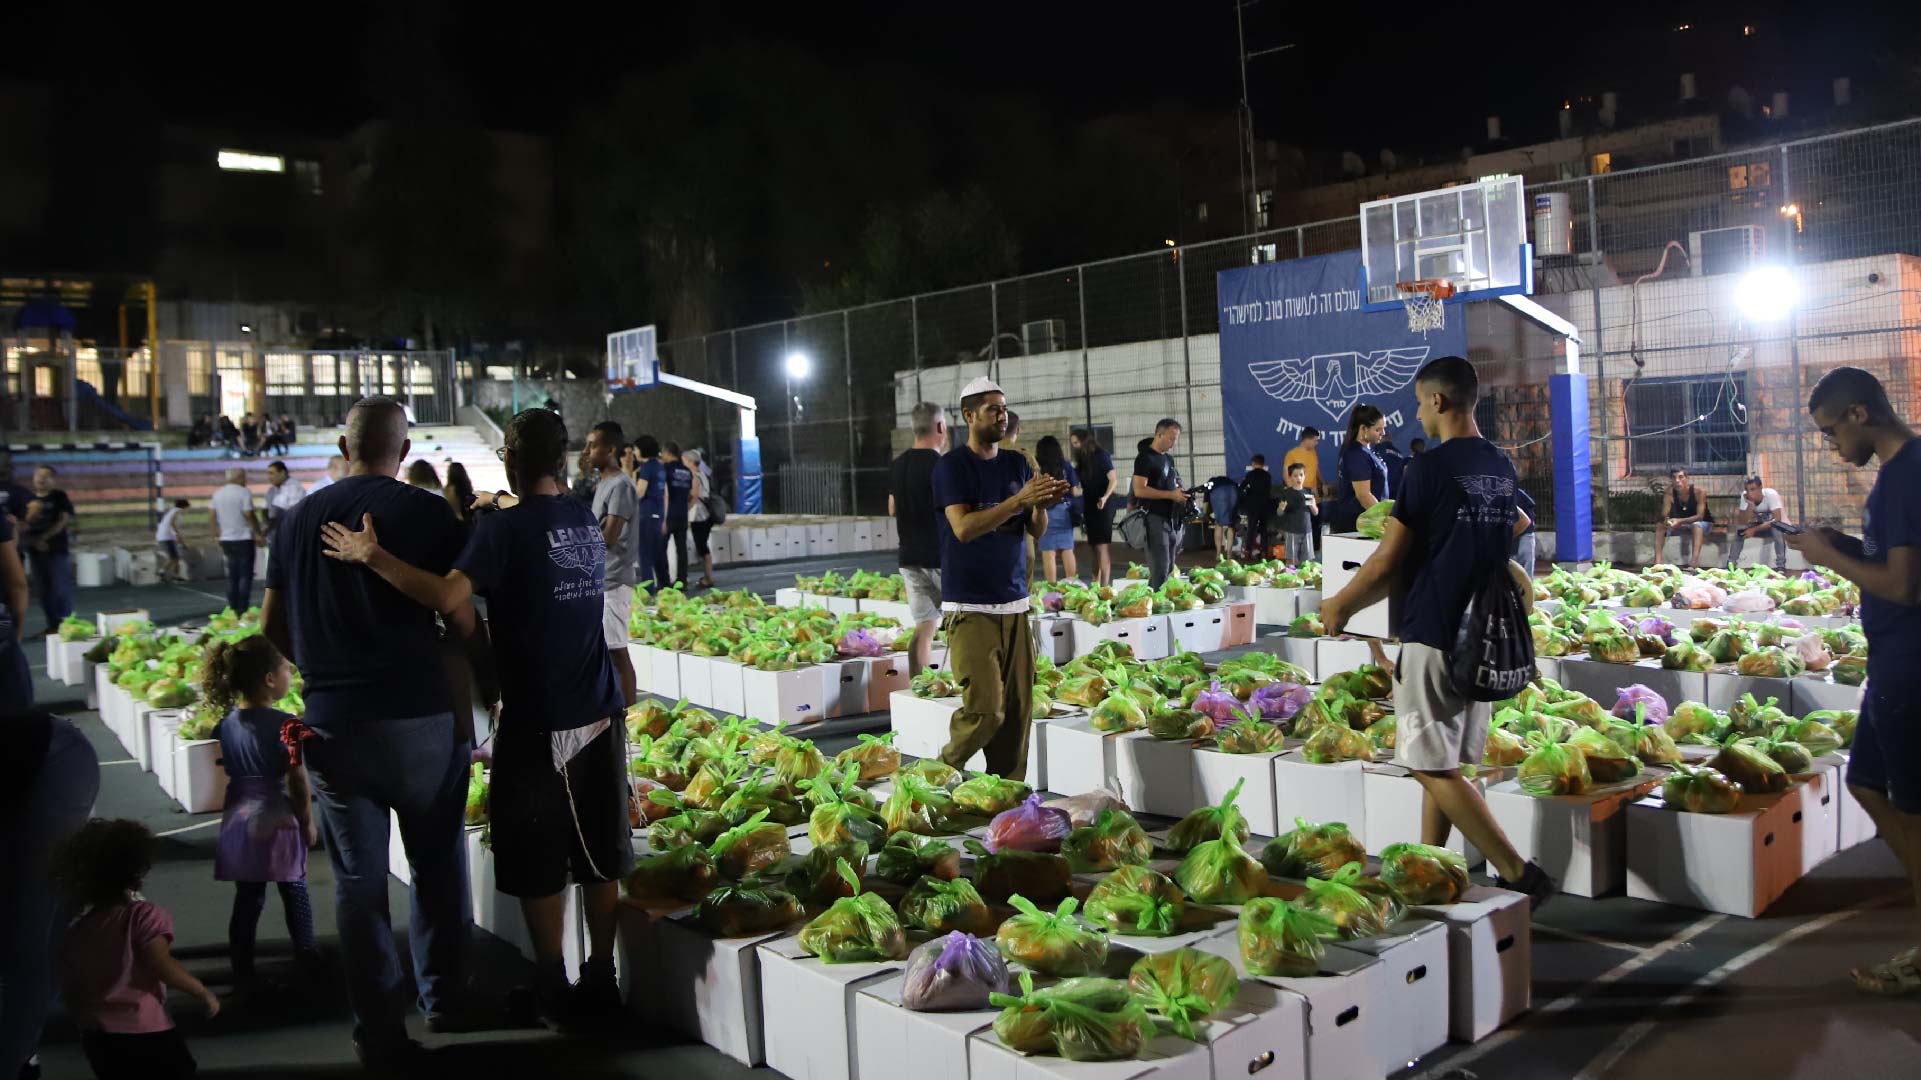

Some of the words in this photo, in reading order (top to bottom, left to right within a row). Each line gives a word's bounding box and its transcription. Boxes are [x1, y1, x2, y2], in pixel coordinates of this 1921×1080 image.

[1265, 300, 1283, 321] טוב
[1285, 291, 1318, 319] לעשות
[1320, 293, 1332, 313] זה
[1335, 288, 1360, 311] עולם
